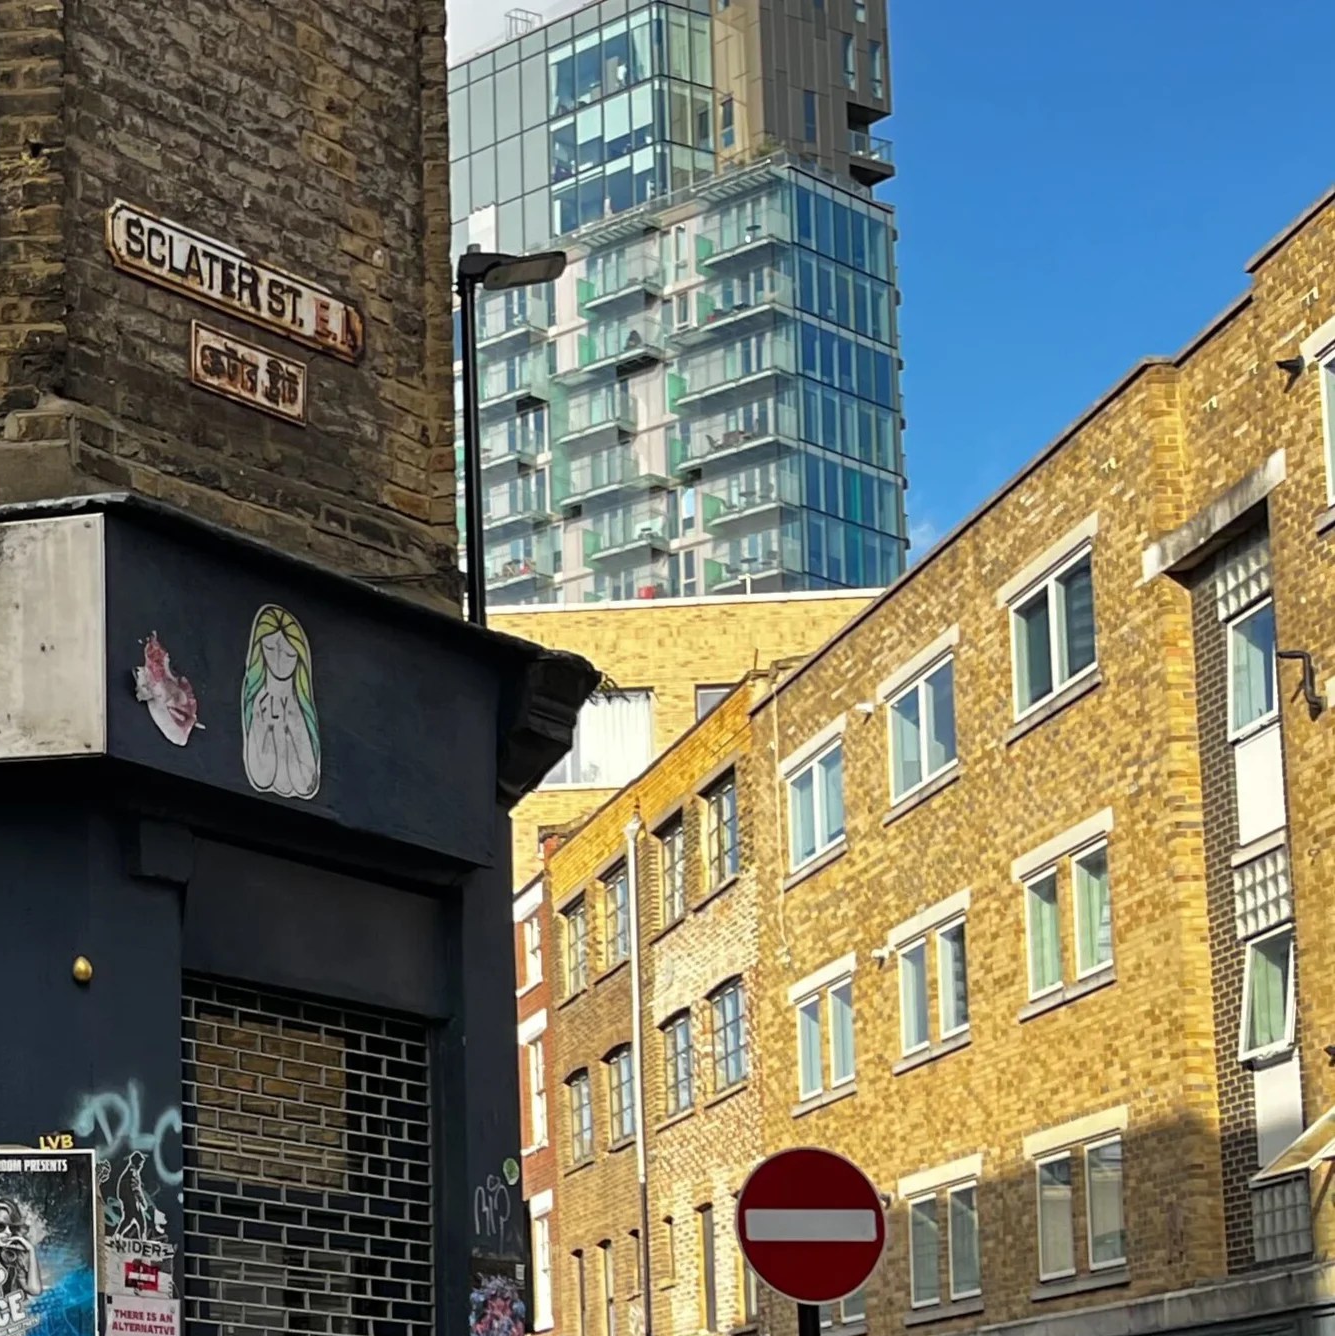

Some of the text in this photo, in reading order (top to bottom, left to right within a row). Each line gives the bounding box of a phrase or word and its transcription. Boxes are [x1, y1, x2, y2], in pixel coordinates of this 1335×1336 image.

[125, 216, 261, 312] SCLATER
[23, 1159, 68, 1173] PRESENTS
[114, 1309, 173, 1323] THERE IS AN
[111, 1321, 175, 1336] ALTERNATIVE
